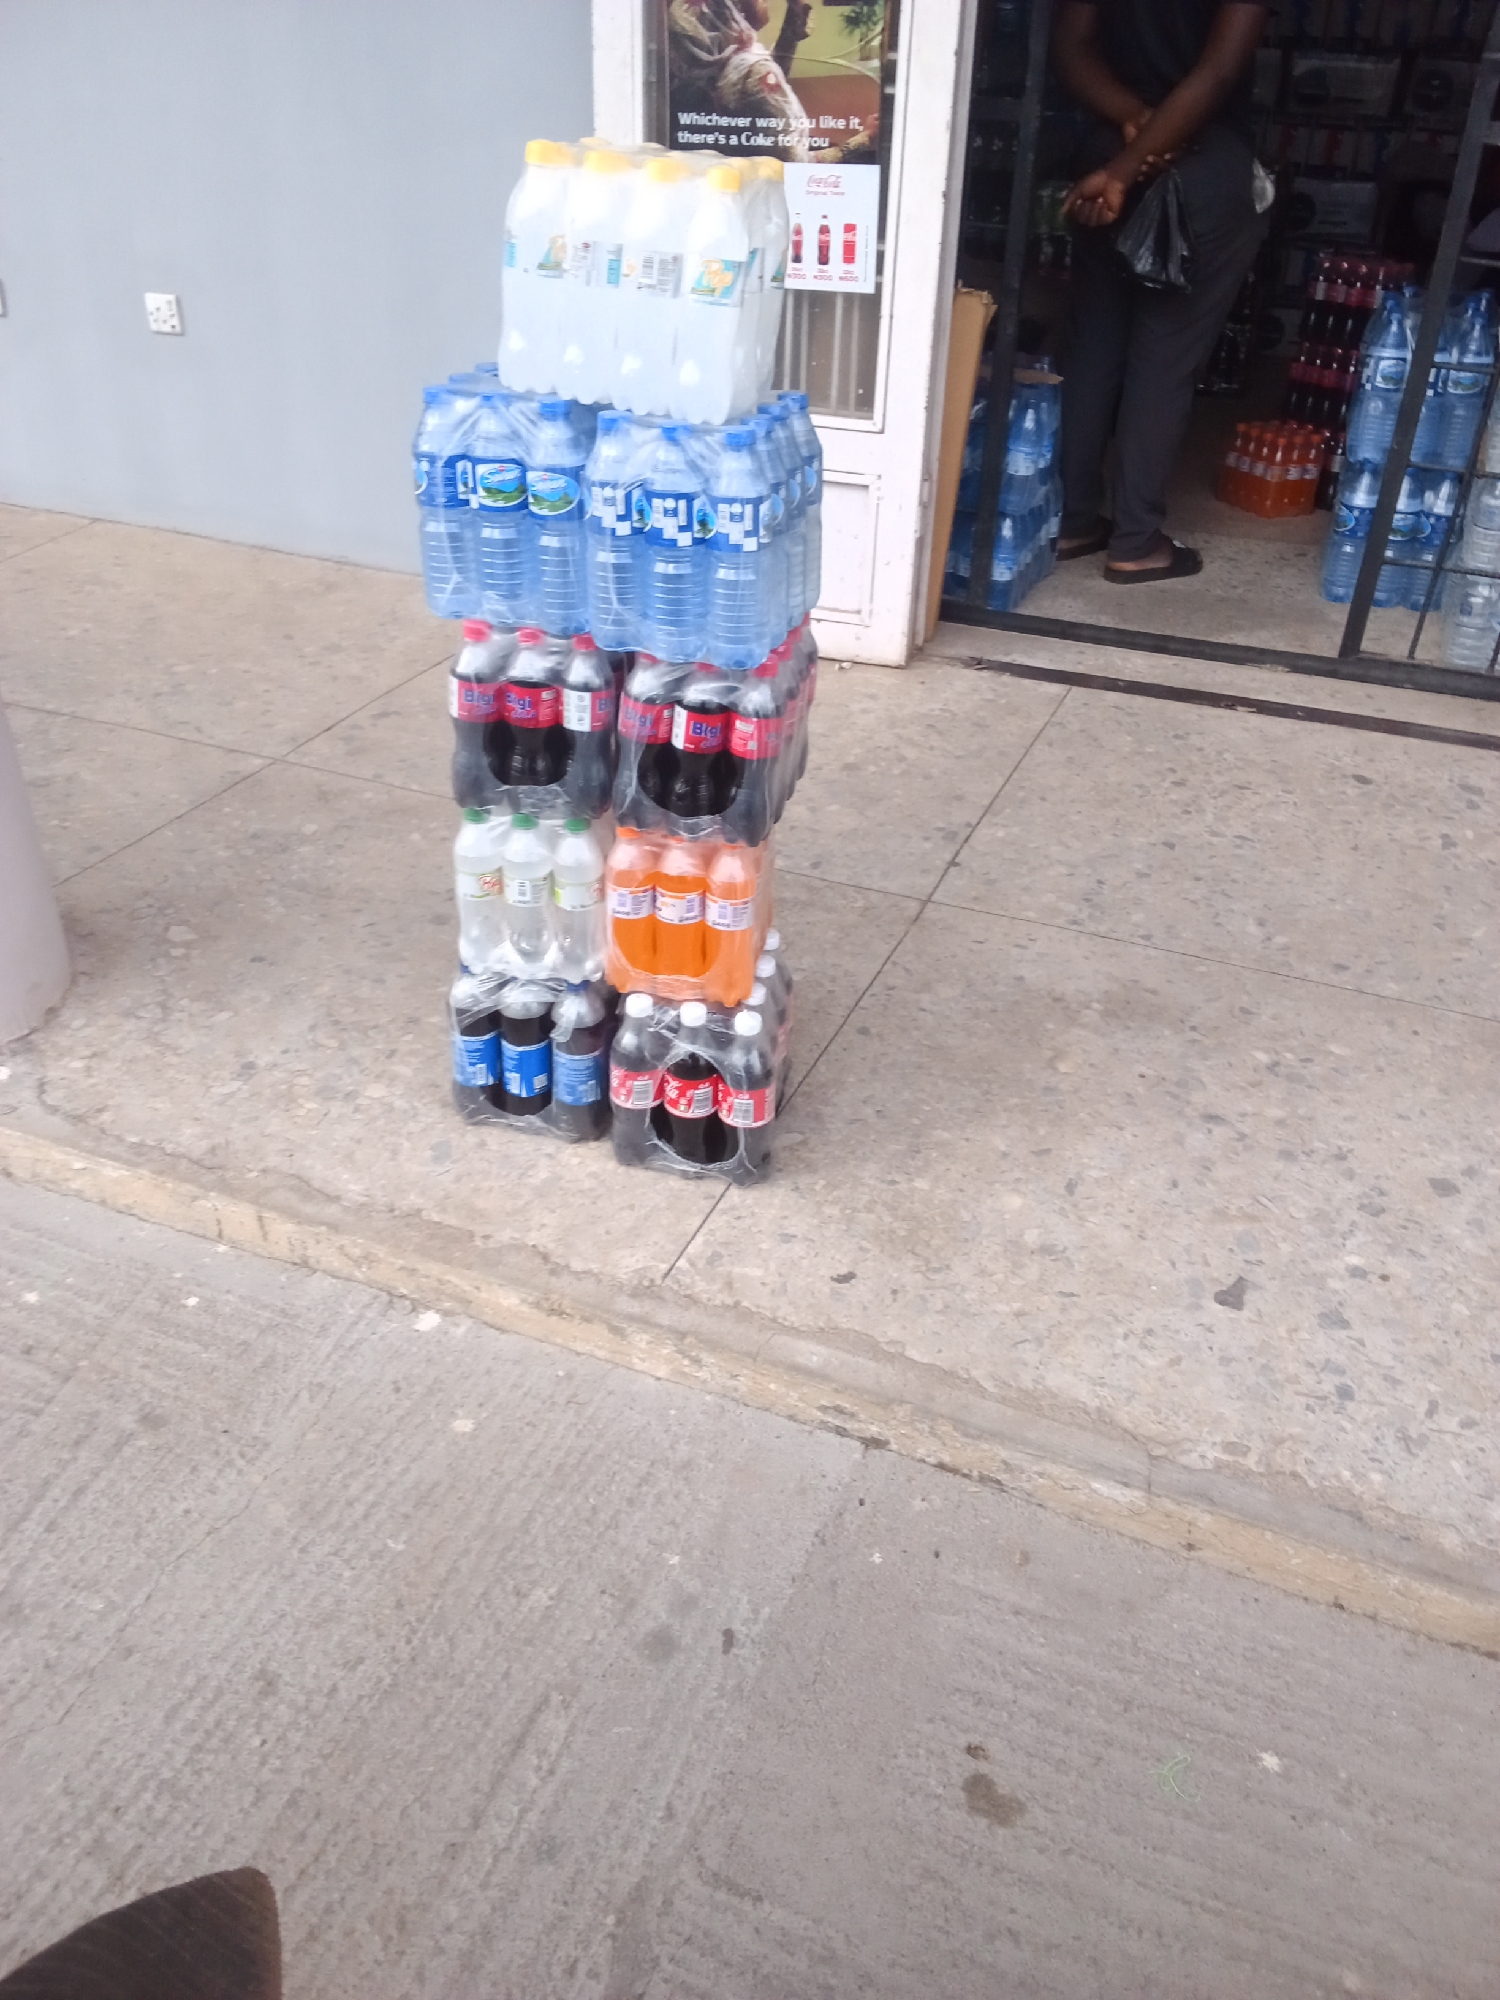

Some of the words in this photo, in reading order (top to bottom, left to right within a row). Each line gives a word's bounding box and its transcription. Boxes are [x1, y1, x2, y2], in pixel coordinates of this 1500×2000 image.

[677, 112, 752, 127] Whichever
[755, 117, 786, 131] way
[789, 117, 816, 132] you
[819, 115, 847, 129] like
[849, 115, 864, 132] it,
[677, 130, 726, 144] there's
[728, 134, 739, 145] a
[741, 131, 776, 146] Coke
[777, 133, 799, 146] for
[801, 137, 830, 150] you
